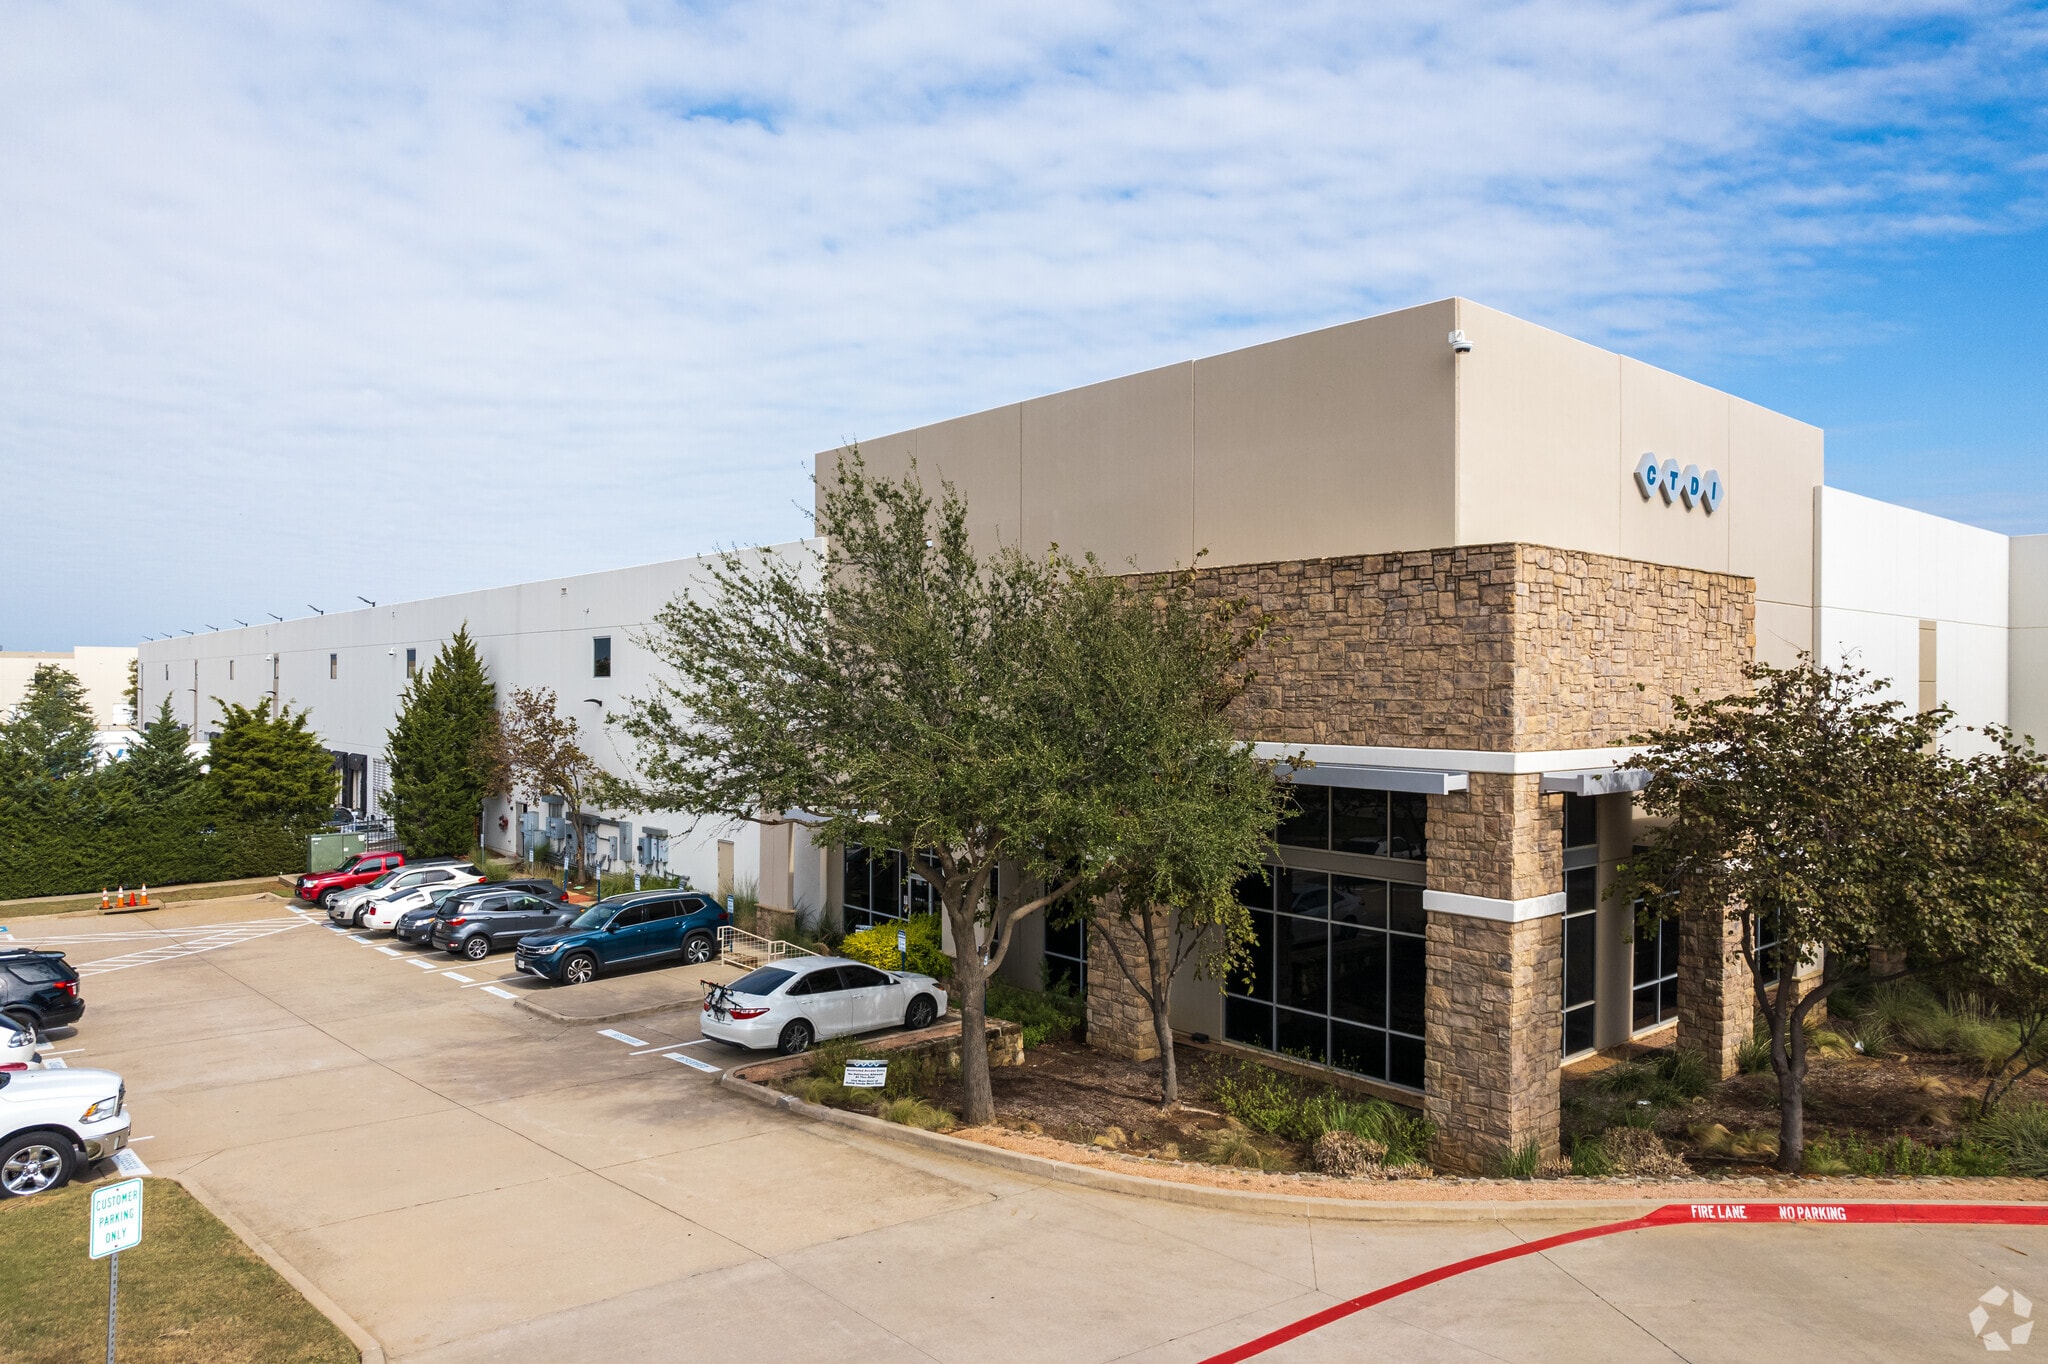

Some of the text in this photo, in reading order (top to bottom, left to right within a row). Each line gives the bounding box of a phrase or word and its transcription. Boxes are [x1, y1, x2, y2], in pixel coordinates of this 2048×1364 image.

[1646, 464, 1717, 500] CTDI
[96, 1189, 138, 1212] CUSTOMER
[98, 1208, 135, 1229] PARKING
[1690, 1204, 1847, 1221] FIRE LANE NO PARKING
[105, 1227, 127, 1244] ONLY
